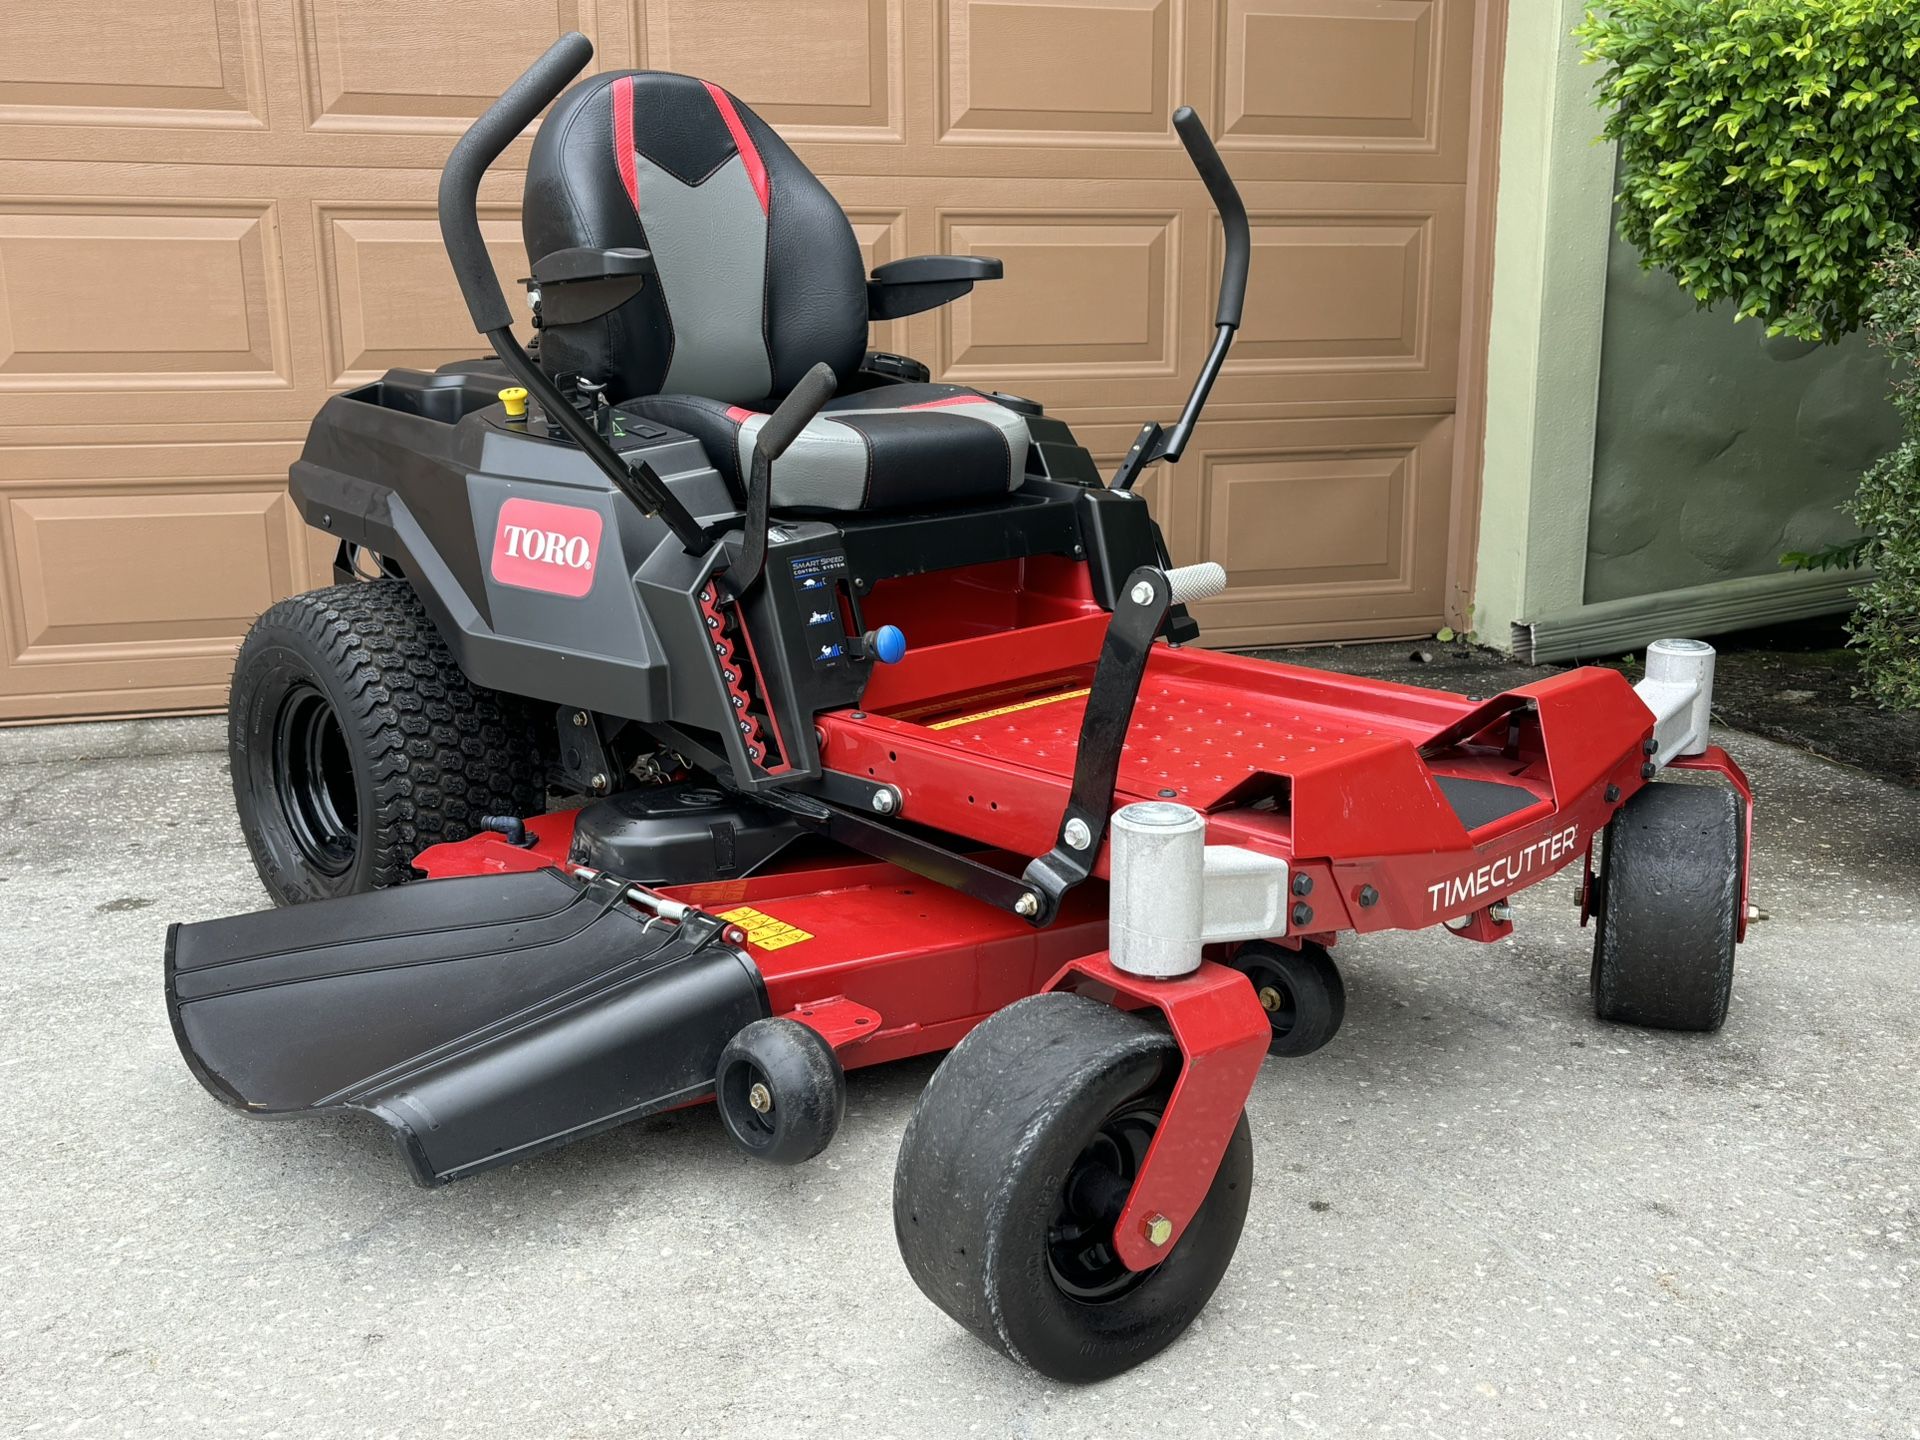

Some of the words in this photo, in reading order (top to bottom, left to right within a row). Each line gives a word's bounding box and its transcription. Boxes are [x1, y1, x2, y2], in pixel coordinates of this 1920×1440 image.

[793, 566, 820, 576] CONTROL
[822, 562, 845, 570] SYSTEM
[707, 617, 718, 627] 4.0
[724, 670, 735, 681] 3.0
[740, 721, 751, 732] 2.0
[1428, 825, 1577, 912] TIMECUTTER
